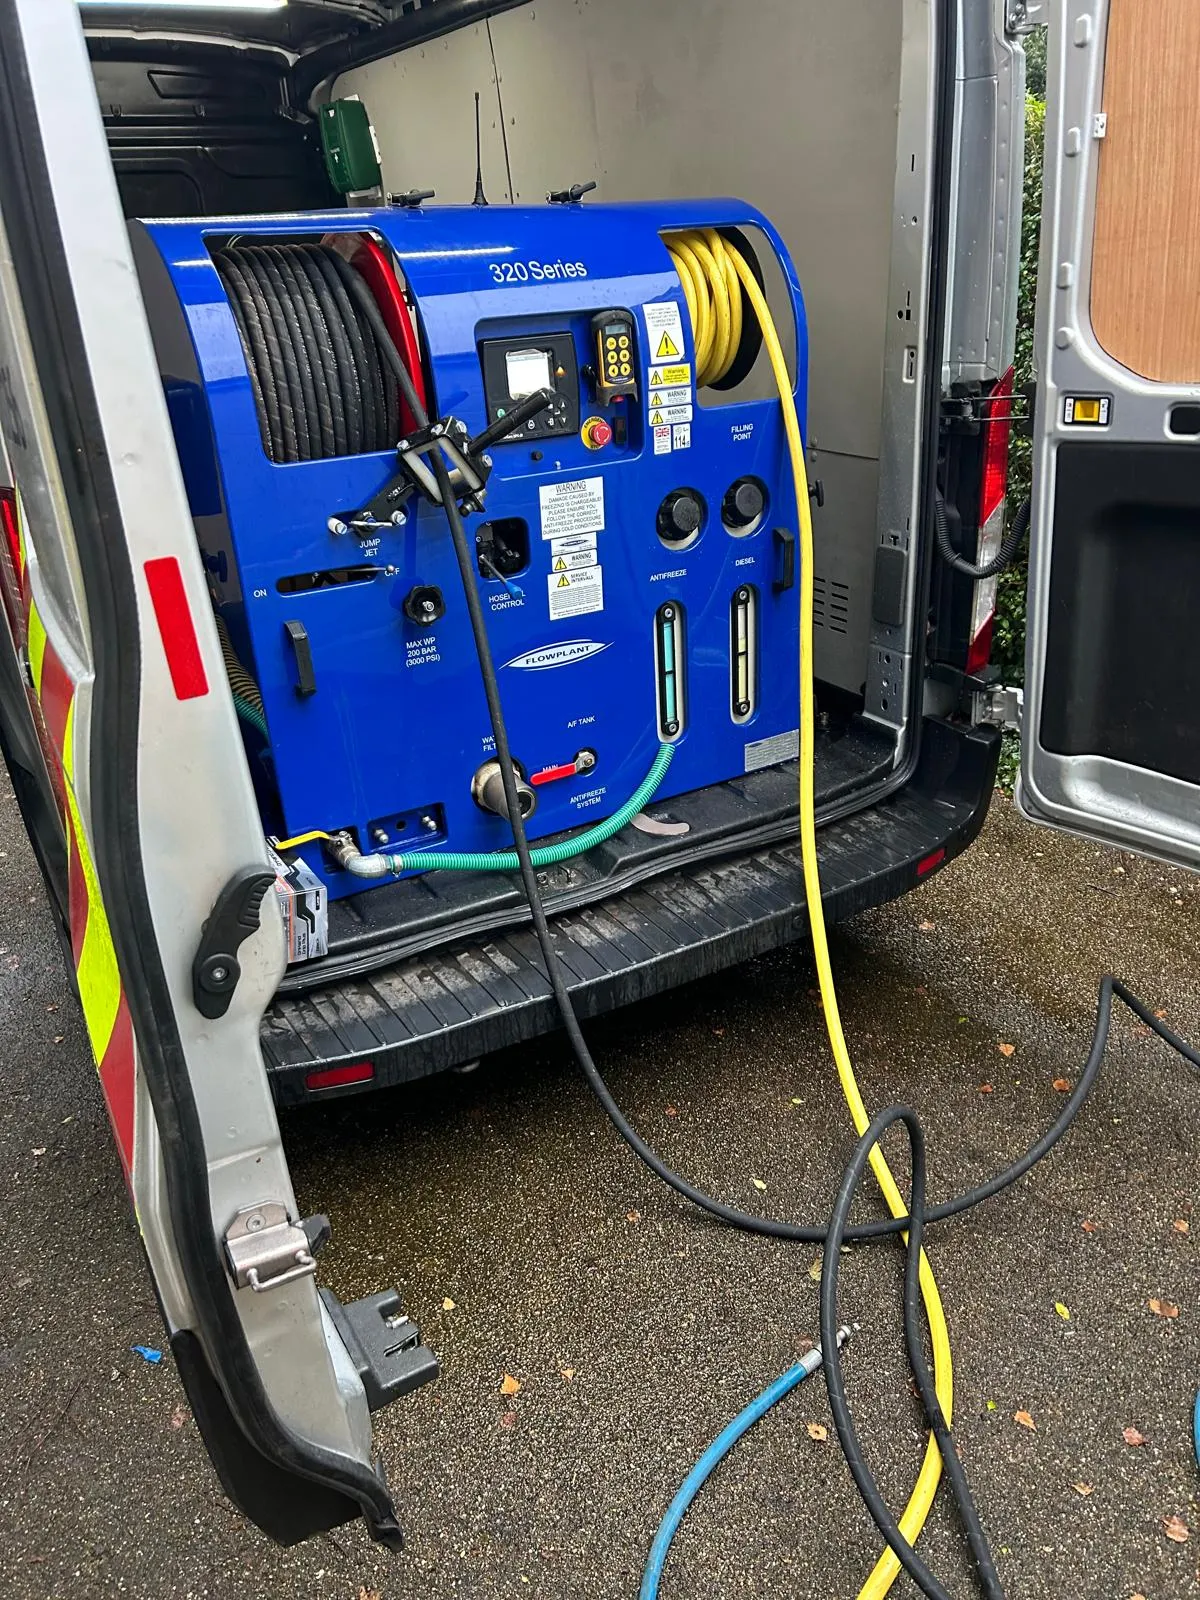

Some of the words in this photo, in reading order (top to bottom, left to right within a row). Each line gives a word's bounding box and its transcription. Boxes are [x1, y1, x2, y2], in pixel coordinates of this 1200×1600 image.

[489, 262, 528, 282] 320
[528, 259, 587, 280] Series
[731, 424, 753, 433] FILLING
[675, 434, 686, 448] 114
[733, 432, 752, 441] POINT
[556, 481, 586, 493] WARNING
[360, 538, 380, 548] JUMP
[364, 548, 378, 557] JET
[572, 552, 592, 560] WARNING
[735, 557, 755, 566] DIESEL
[385, 567, 399, 576] OF
[650, 569, 687, 582] ANTIFREEZE
[254, 589, 267, 598] ON
[491, 599, 524, 610] CONTROL
[406, 640, 422, 649] MAX
[423, 637, 435, 645] WP
[408, 649, 420, 657] 200
[422, 646, 436, 654] BAR
[526, 645, 590, 664] FLOWPLANT
[406, 657, 424, 668] (3000
[426, 654, 440, 662] PSI)
[579, 716, 595, 725] TANK
[483, 743, 496, 751] FILT
[570, 787, 606, 804] ANTIFREEZE
[577, 796, 601, 808] SYSTEM
